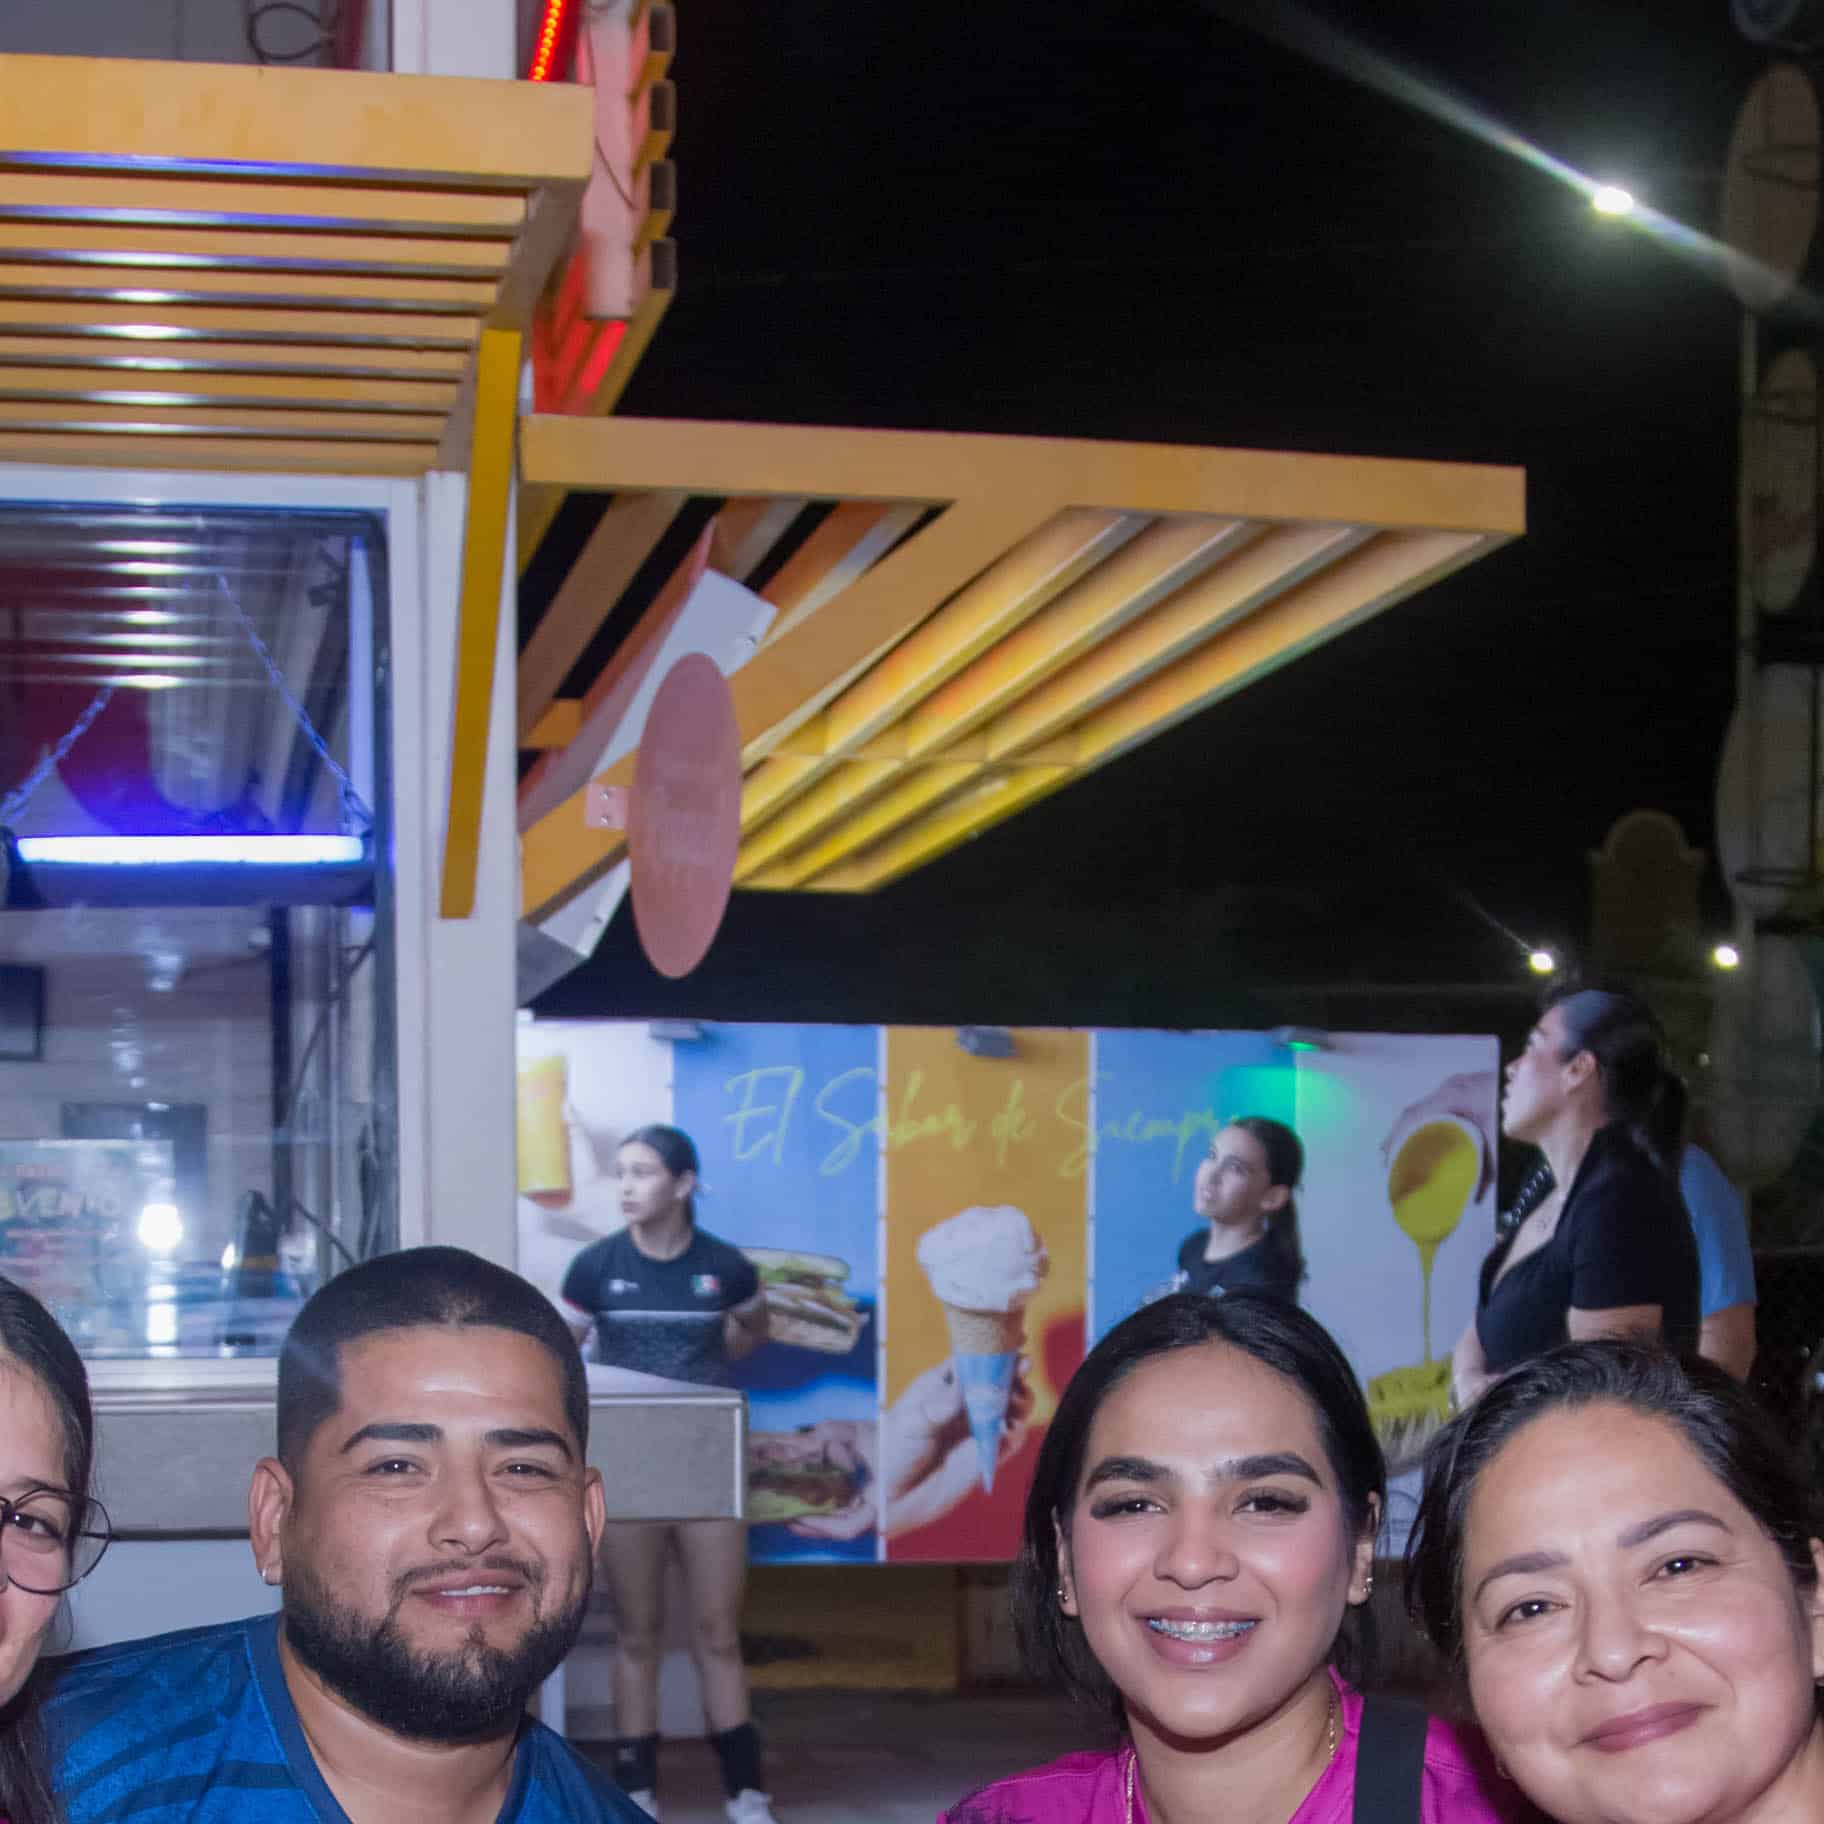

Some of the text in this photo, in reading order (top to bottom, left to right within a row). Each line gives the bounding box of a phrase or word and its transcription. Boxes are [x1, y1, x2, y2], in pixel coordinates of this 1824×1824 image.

[724, 1065, 1239, 1184] El Sabor de Siempr
